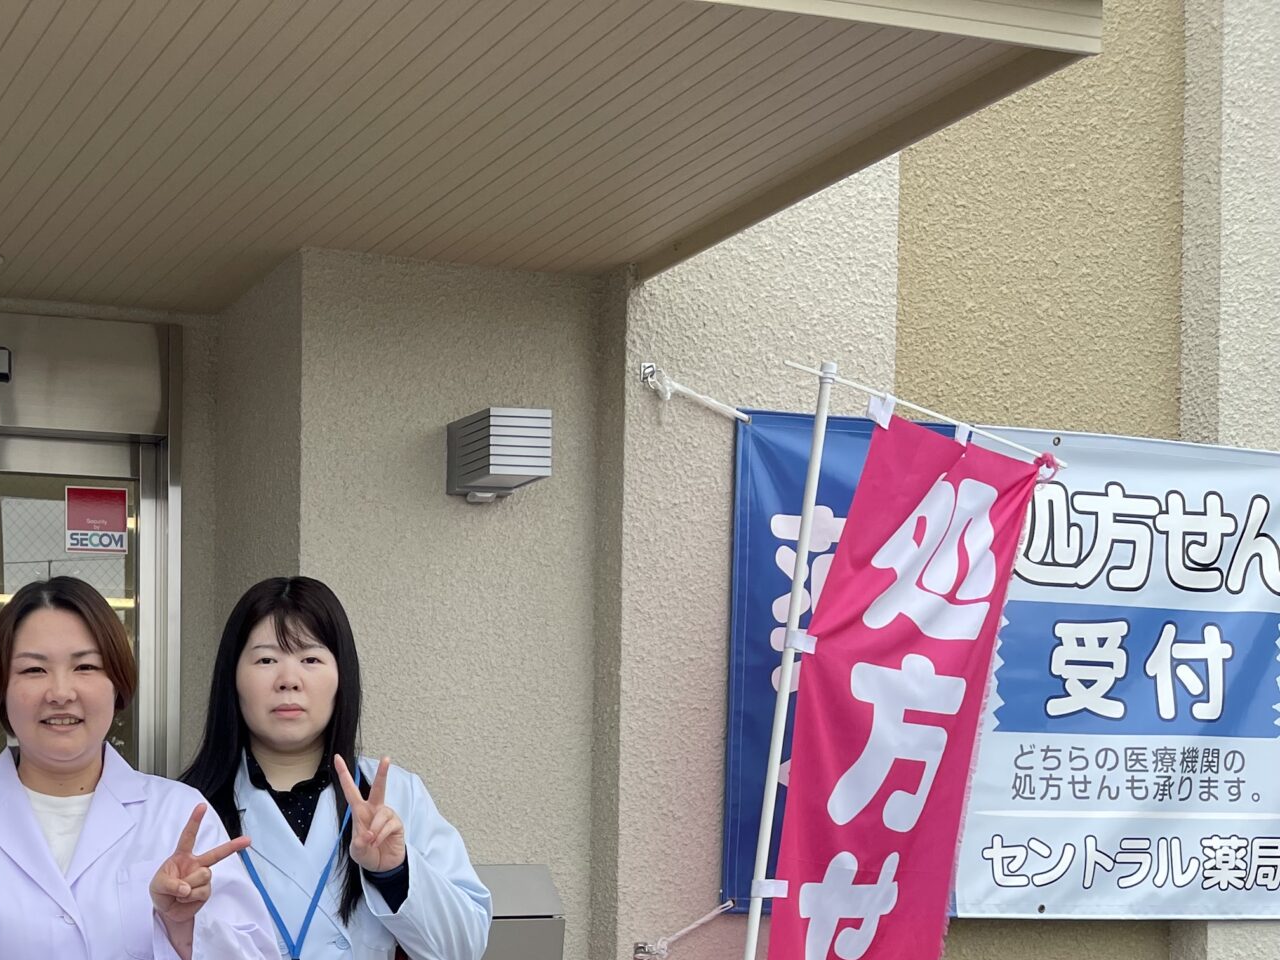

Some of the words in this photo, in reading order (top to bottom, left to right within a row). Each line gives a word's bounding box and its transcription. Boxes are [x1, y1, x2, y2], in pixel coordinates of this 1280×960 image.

[69, 532, 124, 548] SECOM
[1045, 619, 1234, 722] 受付
[1013, 744, 1246, 774] どちらの医療機関の
[1011, 772, 1261, 802] 処方せんも承ります。
[981, 834, 1280, 891] セントラル薬局
